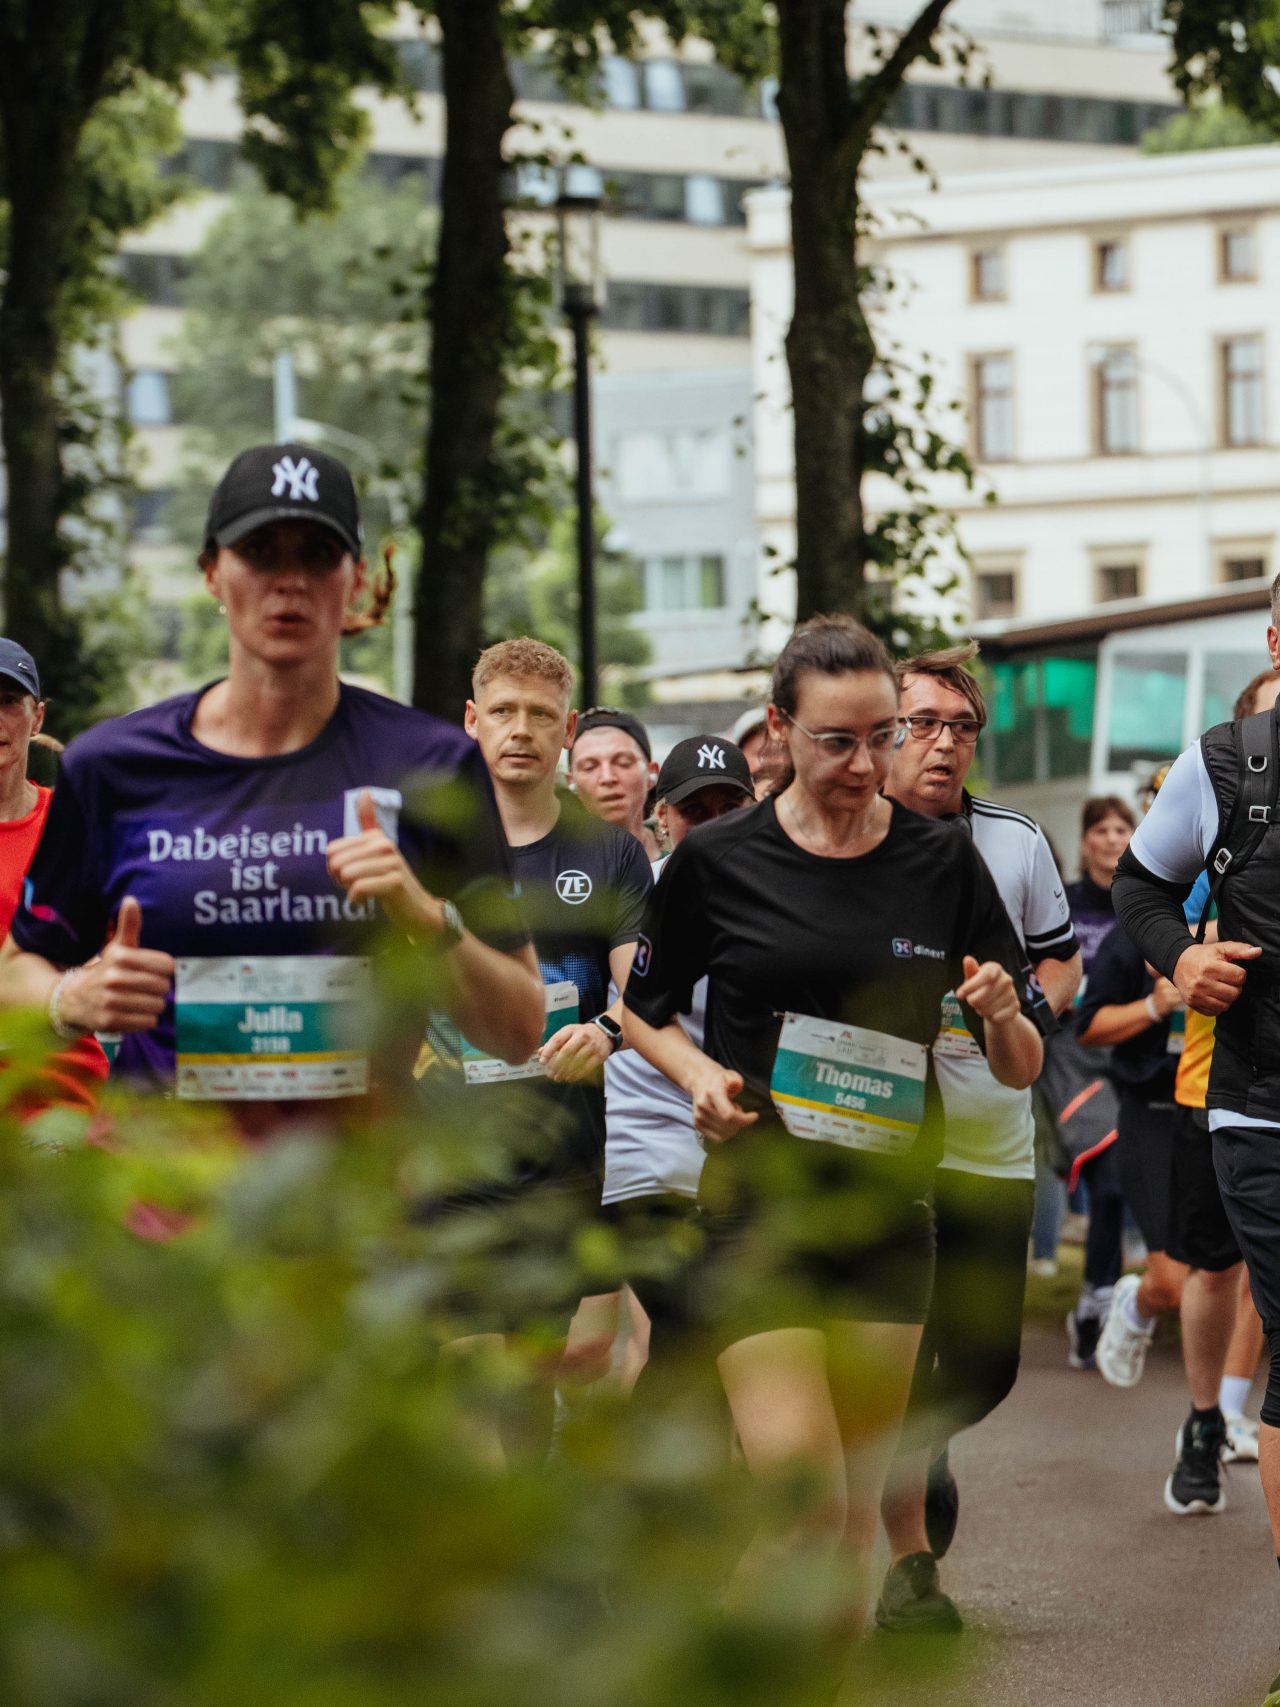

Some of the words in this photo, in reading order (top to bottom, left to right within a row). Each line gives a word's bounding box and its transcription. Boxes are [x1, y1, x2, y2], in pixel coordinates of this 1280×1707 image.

[271, 455, 320, 501] NY
[697, 744, 726, 769] NY
[148, 822, 329, 862] Dabeisein
[230, 858, 279, 891] ist
[238, 1006, 304, 1033] Julia
[815, 1061, 894, 1099] Thomas
[834, 1091, 867, 1111] 5456
